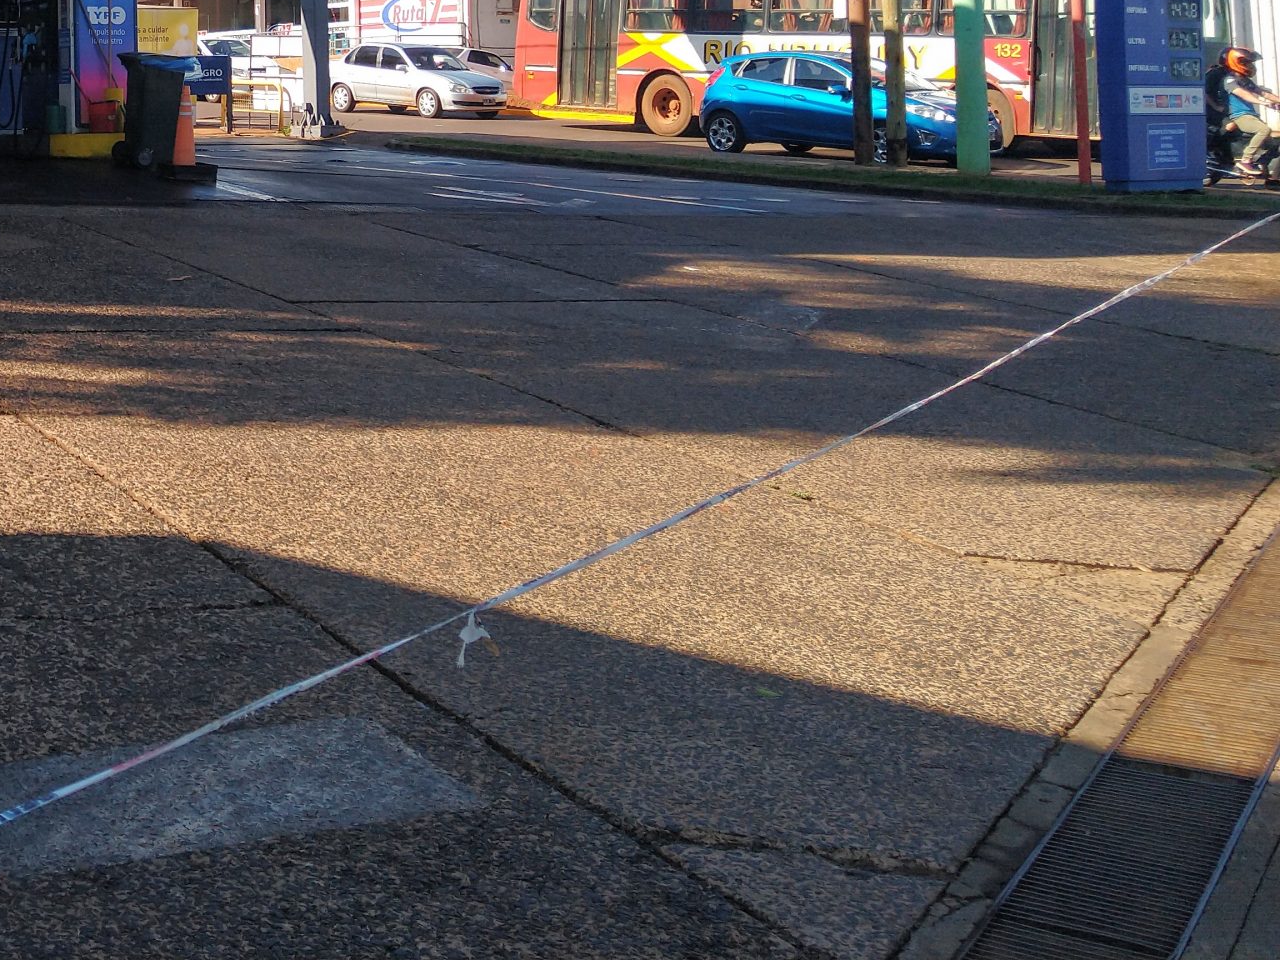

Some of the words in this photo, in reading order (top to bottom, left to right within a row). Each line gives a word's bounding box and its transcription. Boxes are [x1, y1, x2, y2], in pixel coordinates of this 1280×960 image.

[393, 5, 424, 23] Ruta
[148, 25, 169, 33] cuidar
[994, 43, 1022, 58] 132
[201, 69, 223, 77] GRO
